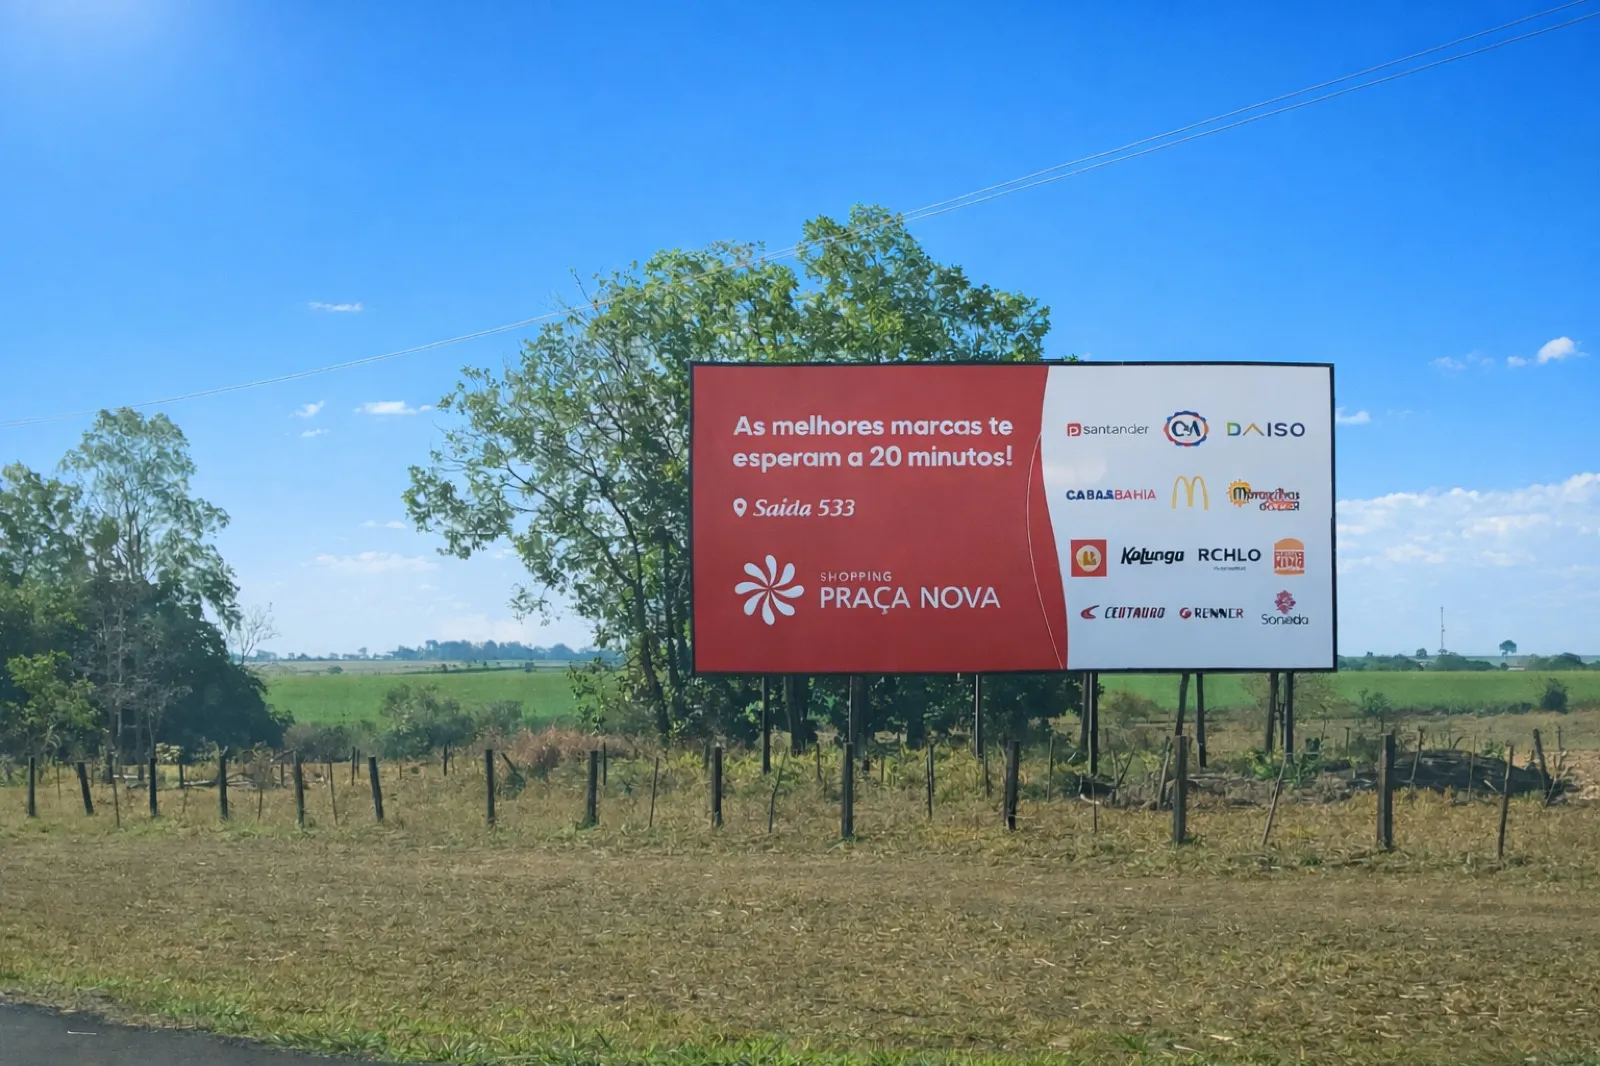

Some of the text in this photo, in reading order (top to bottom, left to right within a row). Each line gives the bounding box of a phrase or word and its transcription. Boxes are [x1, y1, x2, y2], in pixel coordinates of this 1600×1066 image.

[733, 415, 1013, 436] As melhores marcas te
[1227, 423, 1305, 437] DAISO
[733, 446, 1013, 473] esperam a 20 minutos!
[818, 499, 855, 517] 533
[1199, 549, 1261, 561] RCHLO
[820, 571, 892, 582] SHOPPING
[820, 586, 1000, 614] PRAÇA NOVA
[1195, 608, 1243, 619] RENNER
